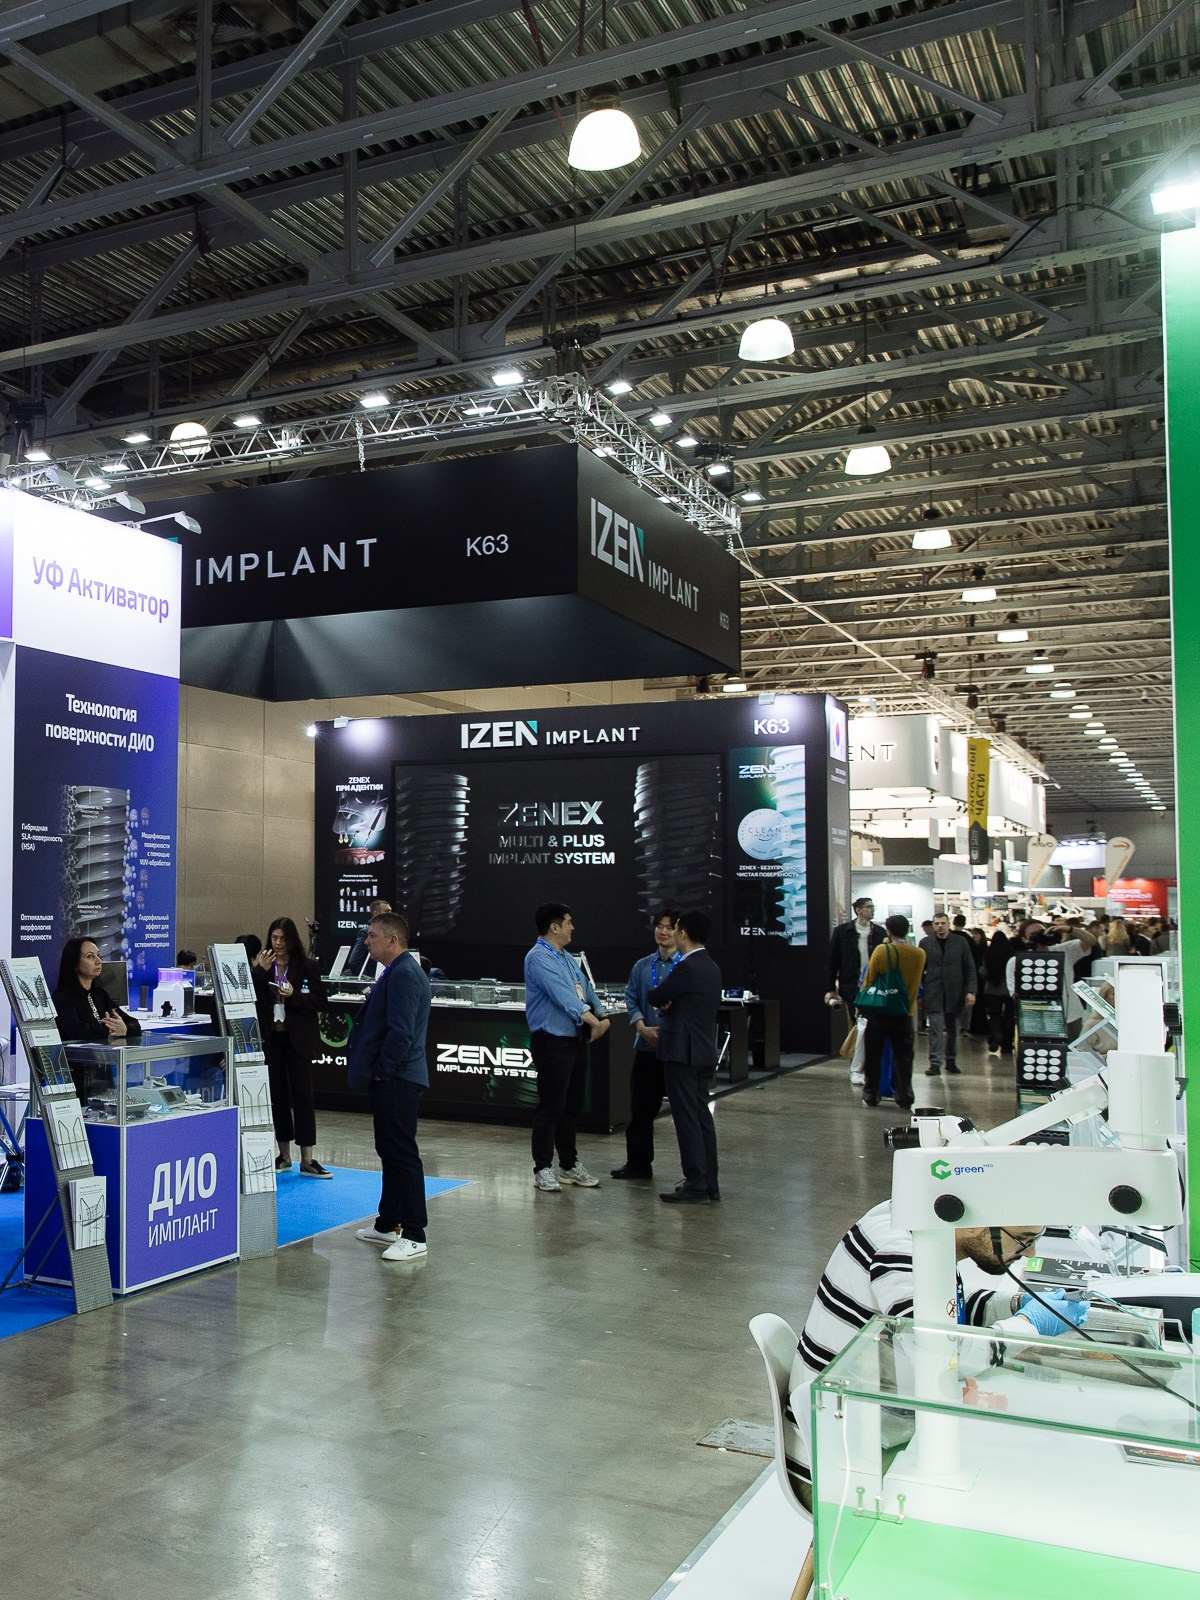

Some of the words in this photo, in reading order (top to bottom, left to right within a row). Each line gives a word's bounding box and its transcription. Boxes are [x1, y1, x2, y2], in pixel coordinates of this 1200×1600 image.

[195, 538, 378, 586] IMPLANT
[466, 534, 510, 557] K63
[591, 497, 644, 583] IZEN
[649, 560, 699, 612] IMPLANT
[32, 555, 65, 589] УФ
[66, 567, 170, 622] Активатор
[65, 693, 137, 722] Технология
[754, 718, 790, 735] K63
[45, 723, 126, 746] поверхности
[128, 732, 154, 752] ДИО
[461, 720, 538, 749] IZEN
[546, 727, 641, 745] IMPLANT
[739, 764, 794, 774] ZENEX
[348, 776, 370, 784] ZENEX
[350, 784, 383, 792] АДЕНТИИ
[975, 773, 986, 816] ЧАСТИ
[498, 800, 604, 826] ZENEX
[21, 823, 48, 833] Гибридная
[21, 833, 63, 843] SLA-поверхность
[499, 835, 543, 848] MULTI
[547, 835, 558, 847] &
[563, 834, 605, 847] PLUS
[21, 843, 35, 851] (HSA)
[489, 853, 550, 865] IMPLANT
[554, 852, 615, 865] SYSTEM
[21, 914, 54, 922] Оптимальная
[338, 920, 357, 928] IZEN
[21, 924, 51, 932] морфология
[20, 934, 52, 942] поверхности
[436, 1043, 533, 1068] ZENEX
[436, 1063, 490, 1075] IMPLANT
[494, 1067, 538, 1079] SYSTE
[954, 1166, 984, 1175] green
[148, 1153, 217, 1222] ДИО
[147, 1208, 218, 1248] ИМПЛАНТ
